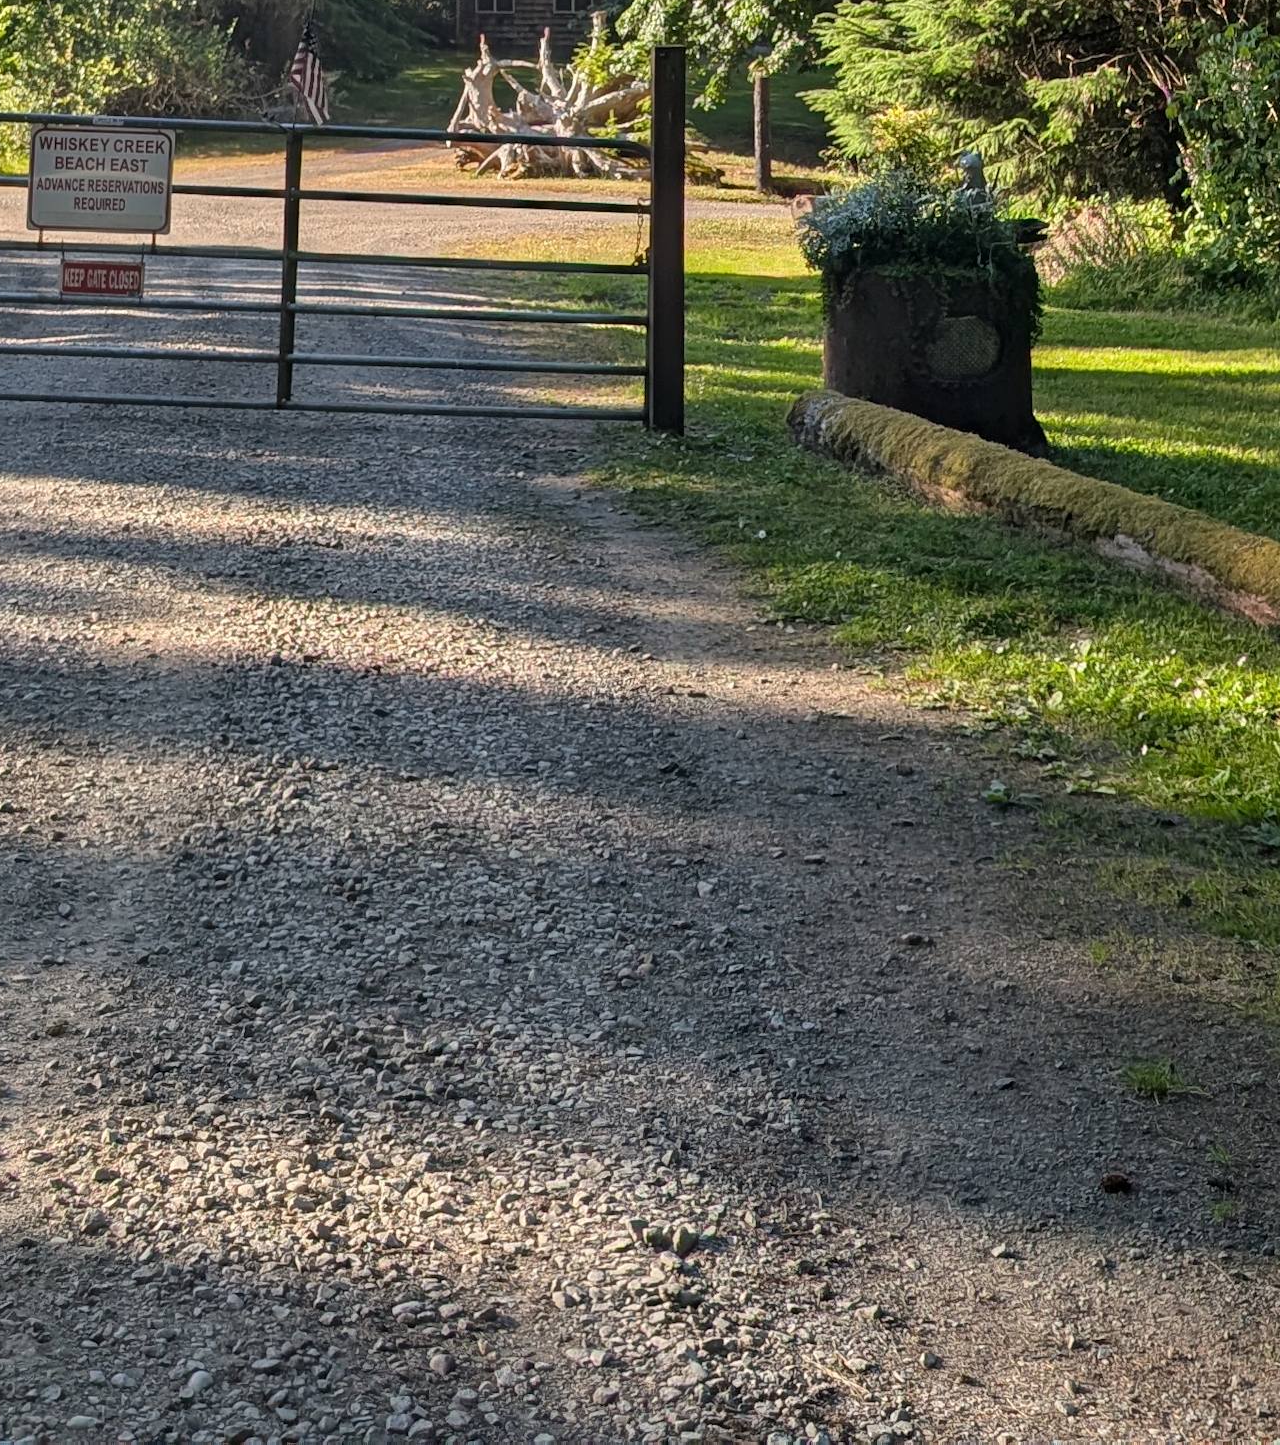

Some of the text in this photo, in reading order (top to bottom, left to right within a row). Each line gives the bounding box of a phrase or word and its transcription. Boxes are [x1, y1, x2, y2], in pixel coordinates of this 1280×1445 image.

[40, 136, 166, 154] WHISKEY CREEK
[55, 156, 149, 173] BEACH EAST
[36, 177, 164, 194] ADVANCE RESERVATIONS
[74, 197, 126, 211] REQUIRED
[64, 268, 140, 290] KEEP GATE CLOSED
